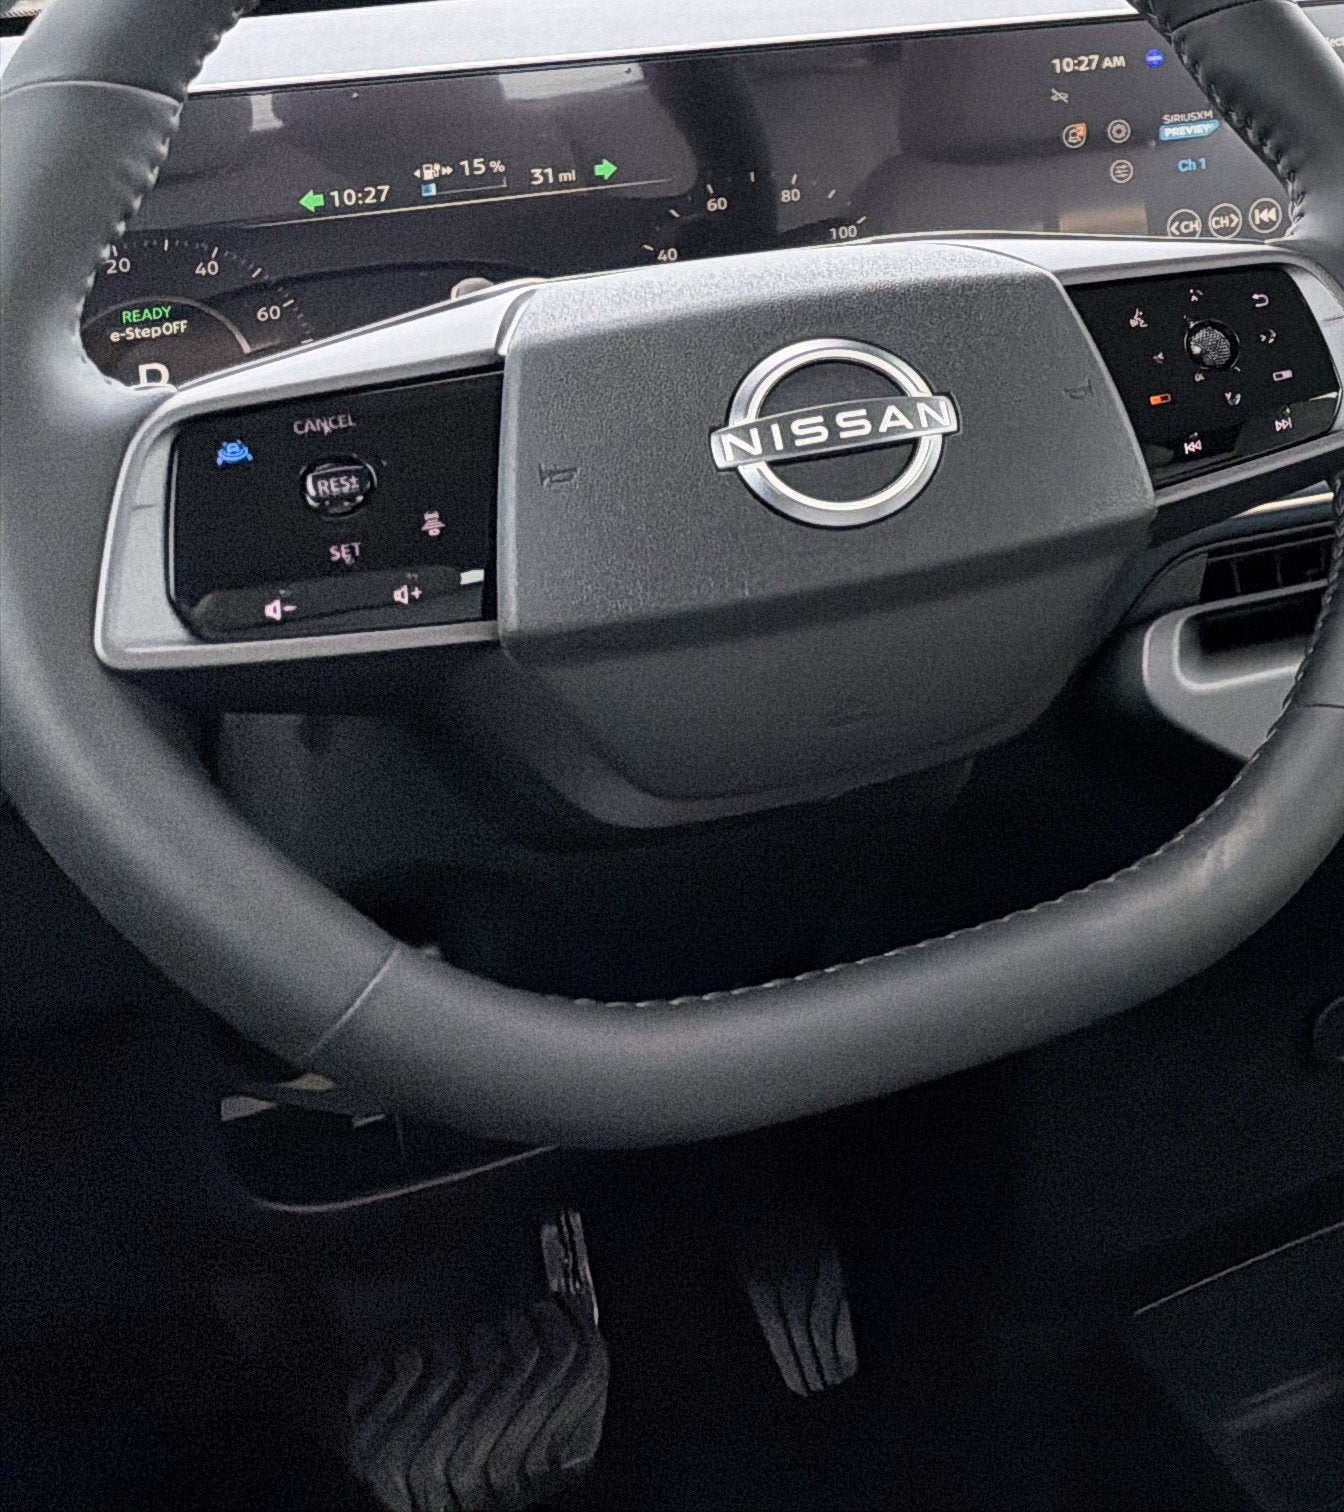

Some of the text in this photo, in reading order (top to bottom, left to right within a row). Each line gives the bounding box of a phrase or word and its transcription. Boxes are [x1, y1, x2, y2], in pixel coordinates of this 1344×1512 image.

[1051, 54, 1100, 74] 10:27
[1102, 55, 1126, 70] AM
[1178, 158, 1197, 172] Ch
[530, 168, 554, 186] 31
[329, 184, 391, 209] 10:27
[706, 197, 729, 212] 60
[780, 188, 801, 203] 80
[829, 224, 858, 240] 100
[657, 247, 678, 262] 40
[106, 257, 131, 275] 20
[195, 260, 219, 277] 40
[122, 305, 172, 324] READY
[256, 305, 281, 322] 60
[293, 413, 358, 436] CANCEL
[719, 400, 952, 462] NISSAN
[329, 541, 361, 565] SET
